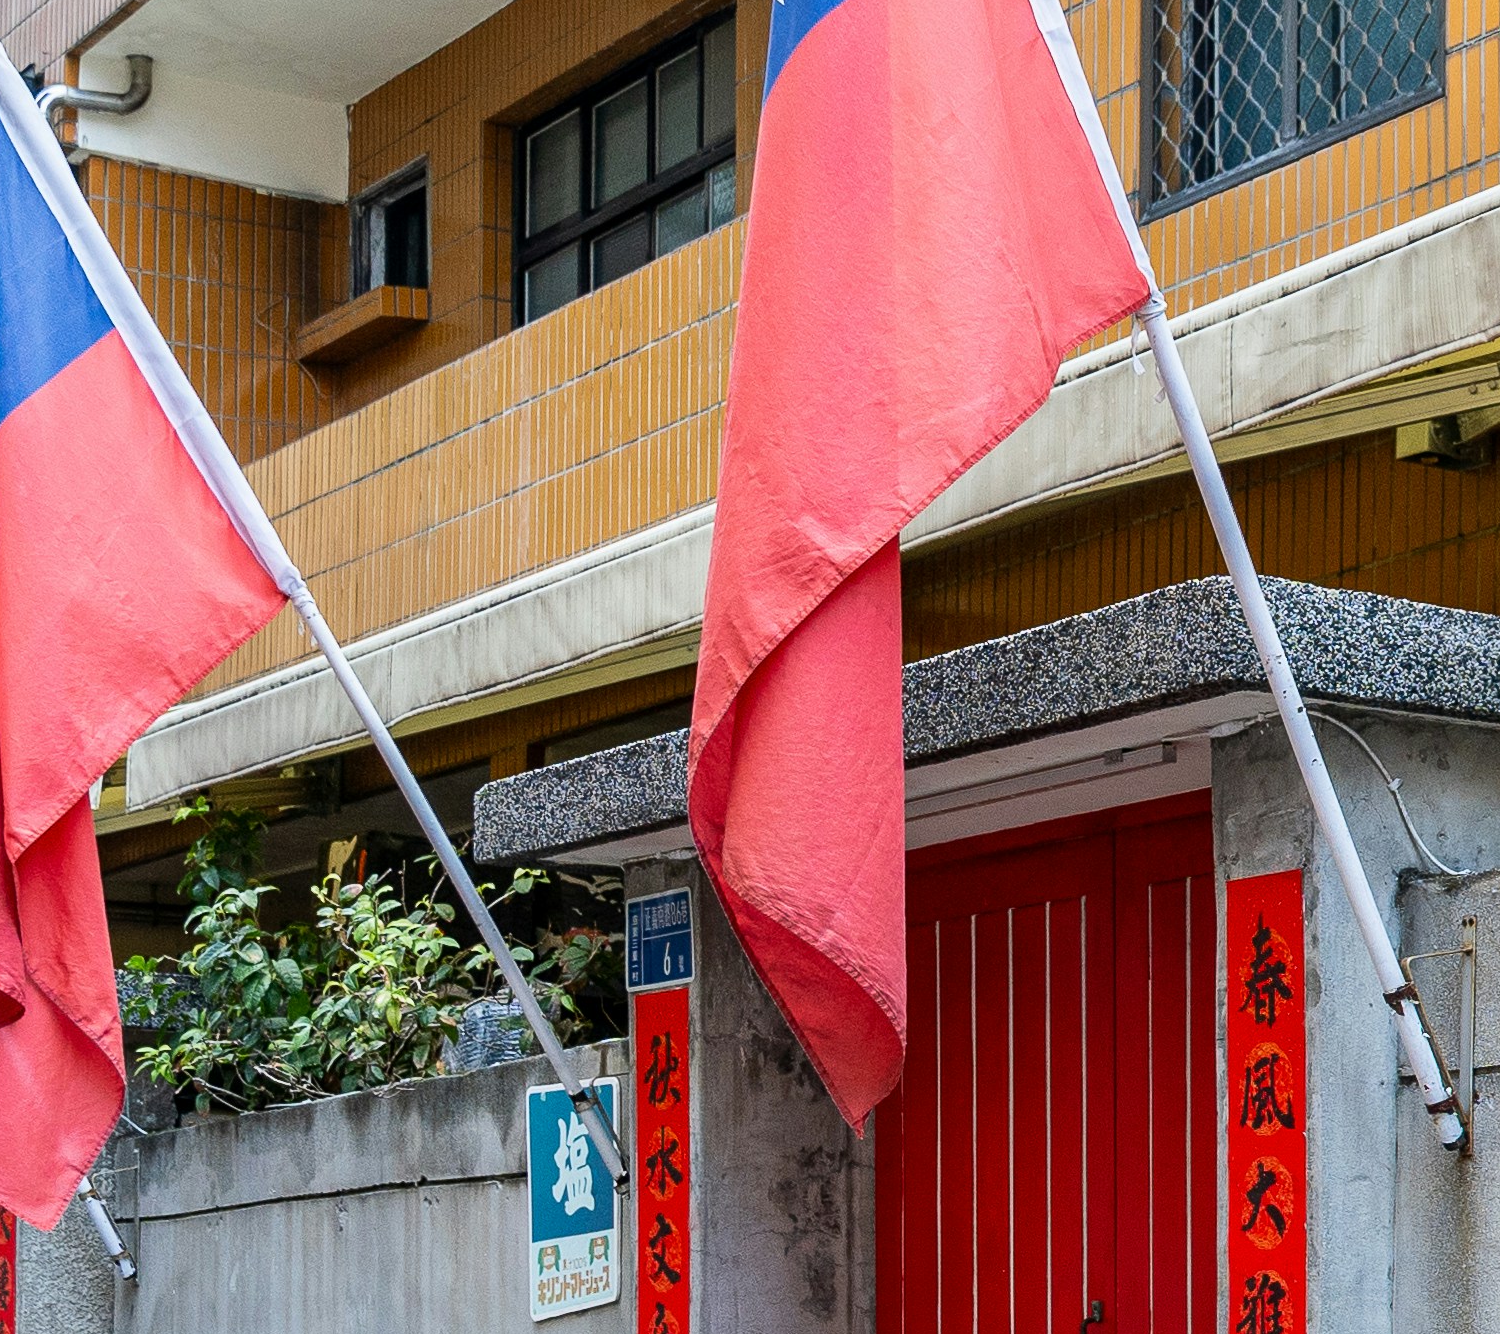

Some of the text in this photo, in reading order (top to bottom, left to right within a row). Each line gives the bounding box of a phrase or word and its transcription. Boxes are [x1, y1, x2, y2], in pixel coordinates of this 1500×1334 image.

[663, 941, 671, 976] 6
[537, 1265, 610, 1306] キリントマトジュース
